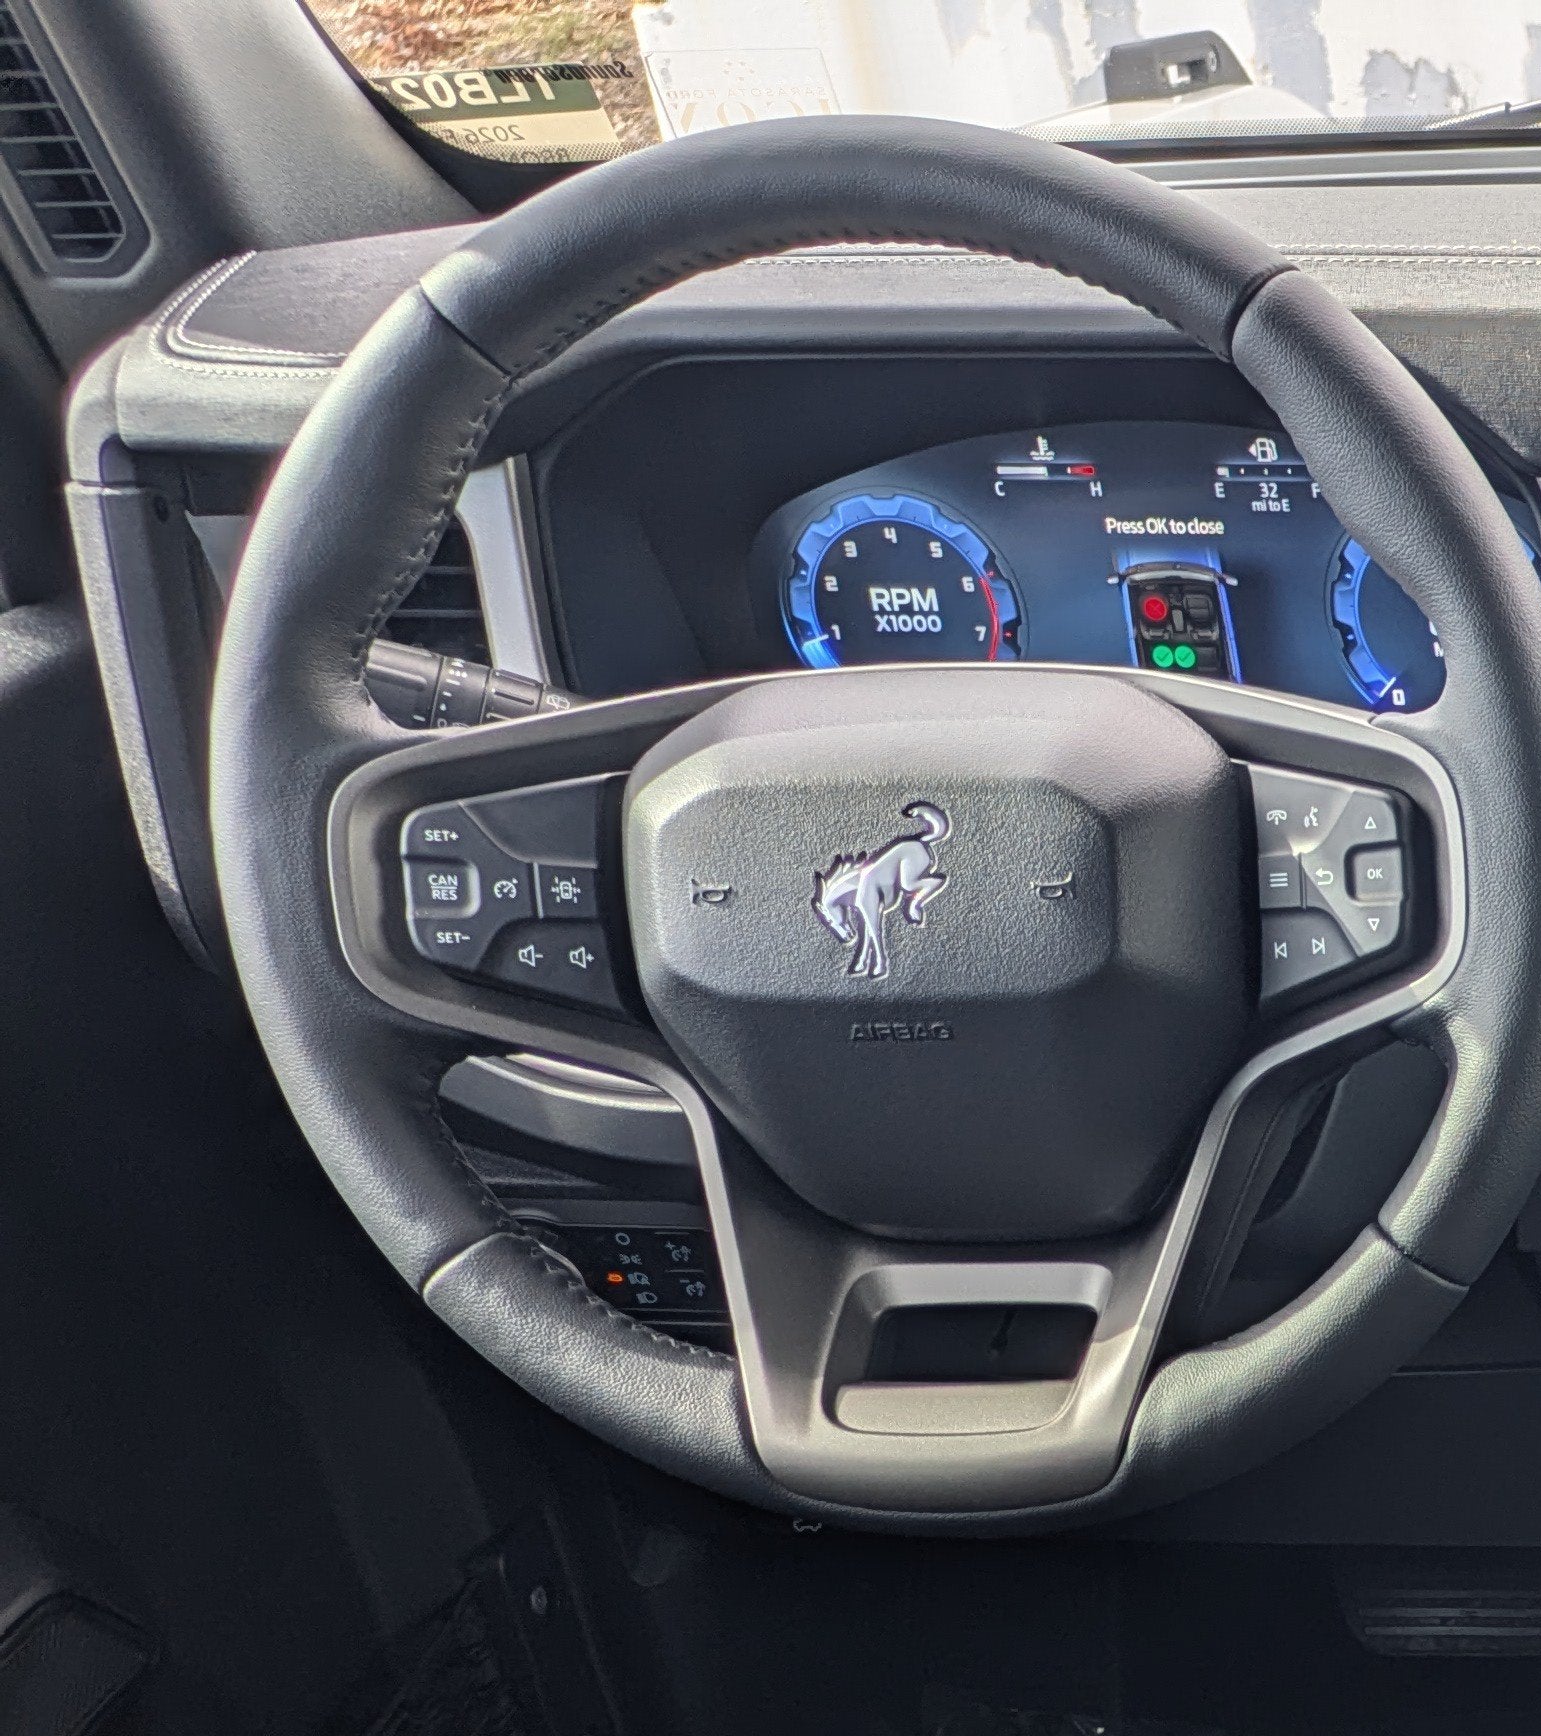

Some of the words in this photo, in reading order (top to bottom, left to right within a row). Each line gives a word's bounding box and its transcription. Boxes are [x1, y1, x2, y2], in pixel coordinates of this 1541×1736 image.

[995, 482, 1005, 497] C
[1090, 482, 1103, 497] H
[1215, 483, 1225, 499] E
[1259, 483, 1278, 499] 32
[1251, 500, 1265, 512] mi
[1268, 500, 1280, 512] to
[1282, 500, 1290, 512] E
[1106, 518, 1144, 535] Press
[1146, 518, 1169, 534] OK
[1171, 519, 1186, 534] to
[1189, 518, 1224, 534] close
[884, 527, 898, 543] 4
[843, 541, 857, 557] 3
[929, 542, 943, 558] 5
[824, 576, 838, 592] 2
[962, 577, 975, 593] 6
[869, 588, 939, 612] RPM
[875, 615, 942, 633] X1000
[832, 625, 841, 640] 1
[975, 626, 986, 641] 7
[425, 829, 459, 842] SET+
[428, 874, 457, 886] CAN
[1367, 868, 1383, 880] OK
[432, 889, 457, 901] RES
[849, 1021, 954, 1042] AIRBAG
